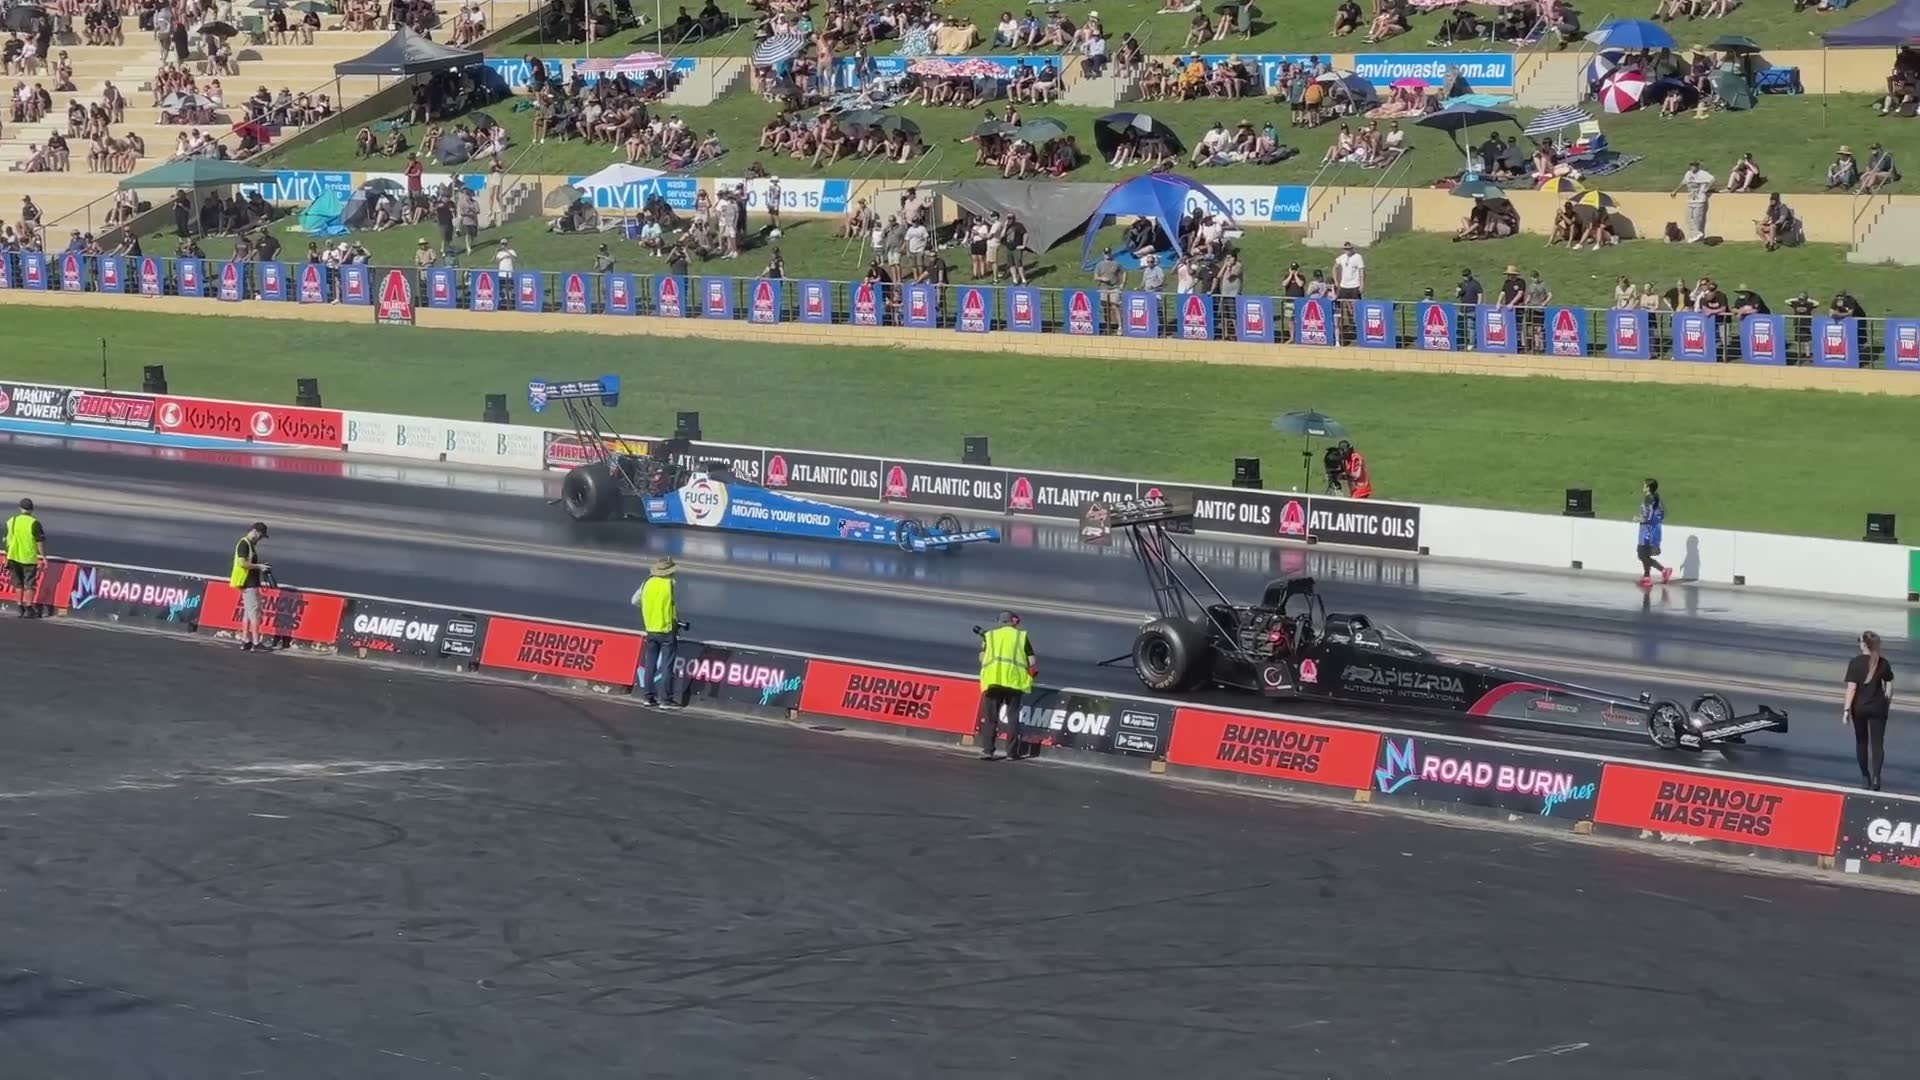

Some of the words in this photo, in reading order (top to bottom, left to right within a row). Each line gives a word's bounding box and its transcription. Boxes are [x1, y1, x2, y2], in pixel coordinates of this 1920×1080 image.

[1356, 59, 1505, 78] envirowasteom.au
[782, 191, 797, 207] 13
[802, 192, 819, 208] 15
[1251, 198, 1271, 217] 15
[1132, 310, 1144, 318] TOP
[1248, 314, 1260, 323] TOP
[1368, 319, 1380, 328] TOP
[1489, 324, 1501, 333] TOP
[1621, 328, 1634, 338] TOP
[1686, 331, 1700, 341] TOP
[1755, 333, 1769, 343] TOP
[1828, 336, 1842, 346] TOP
[1901, 340, 1915, 350] TOP
[16, 403, 62, 419] POWER!
[185, 407, 241, 432] Kubota
[278, 415, 336, 440] Kubota
[791, 463, 845, 487] ATLANTIC
[849, 468, 879, 489] OILS
[911, 474, 970, 497] ATLANTIC
[973, 481, 1002, 500] OILS
[684, 491, 720, 506] FUCHS
[770, 510, 796, 521] YOUR
[797, 513, 831, 527] WORLD
[1239, 503, 1271, 525] OILS
[1308, 510, 1378, 533] ATLANTIC
[1382, 516, 1415, 538] OILS
[100, 579, 140, 601] ROAD
[143, 585, 188, 608] BURN
[354, 614, 406, 638] GAME
[406, 621, 439, 643] ON!
[522, 630, 603, 654] BURNOUT
[517, 646, 595, 671] MASTERS
[673, 656, 725, 682] ROAD
[728, 663, 785, 689] BURN
[848, 674, 940, 701] BURNOUT
[1343, 683, 1394, 696] AUTOSPORT
[842, 691, 931, 719] MASTERS
[1067, 711, 1111, 736] ON!
[1222, 724, 1330, 754] BURNOUT
[1216, 743, 1320, 774] MASTERS
[1422, 755, 1493, 786] ROAD
[1496, 766, 1574, 796] BURN
[1541, 781, 1596, 816] games
[1657, 781, 1783, 816] BURNOUT
[1650, 802, 1772, 837] MASTERS
